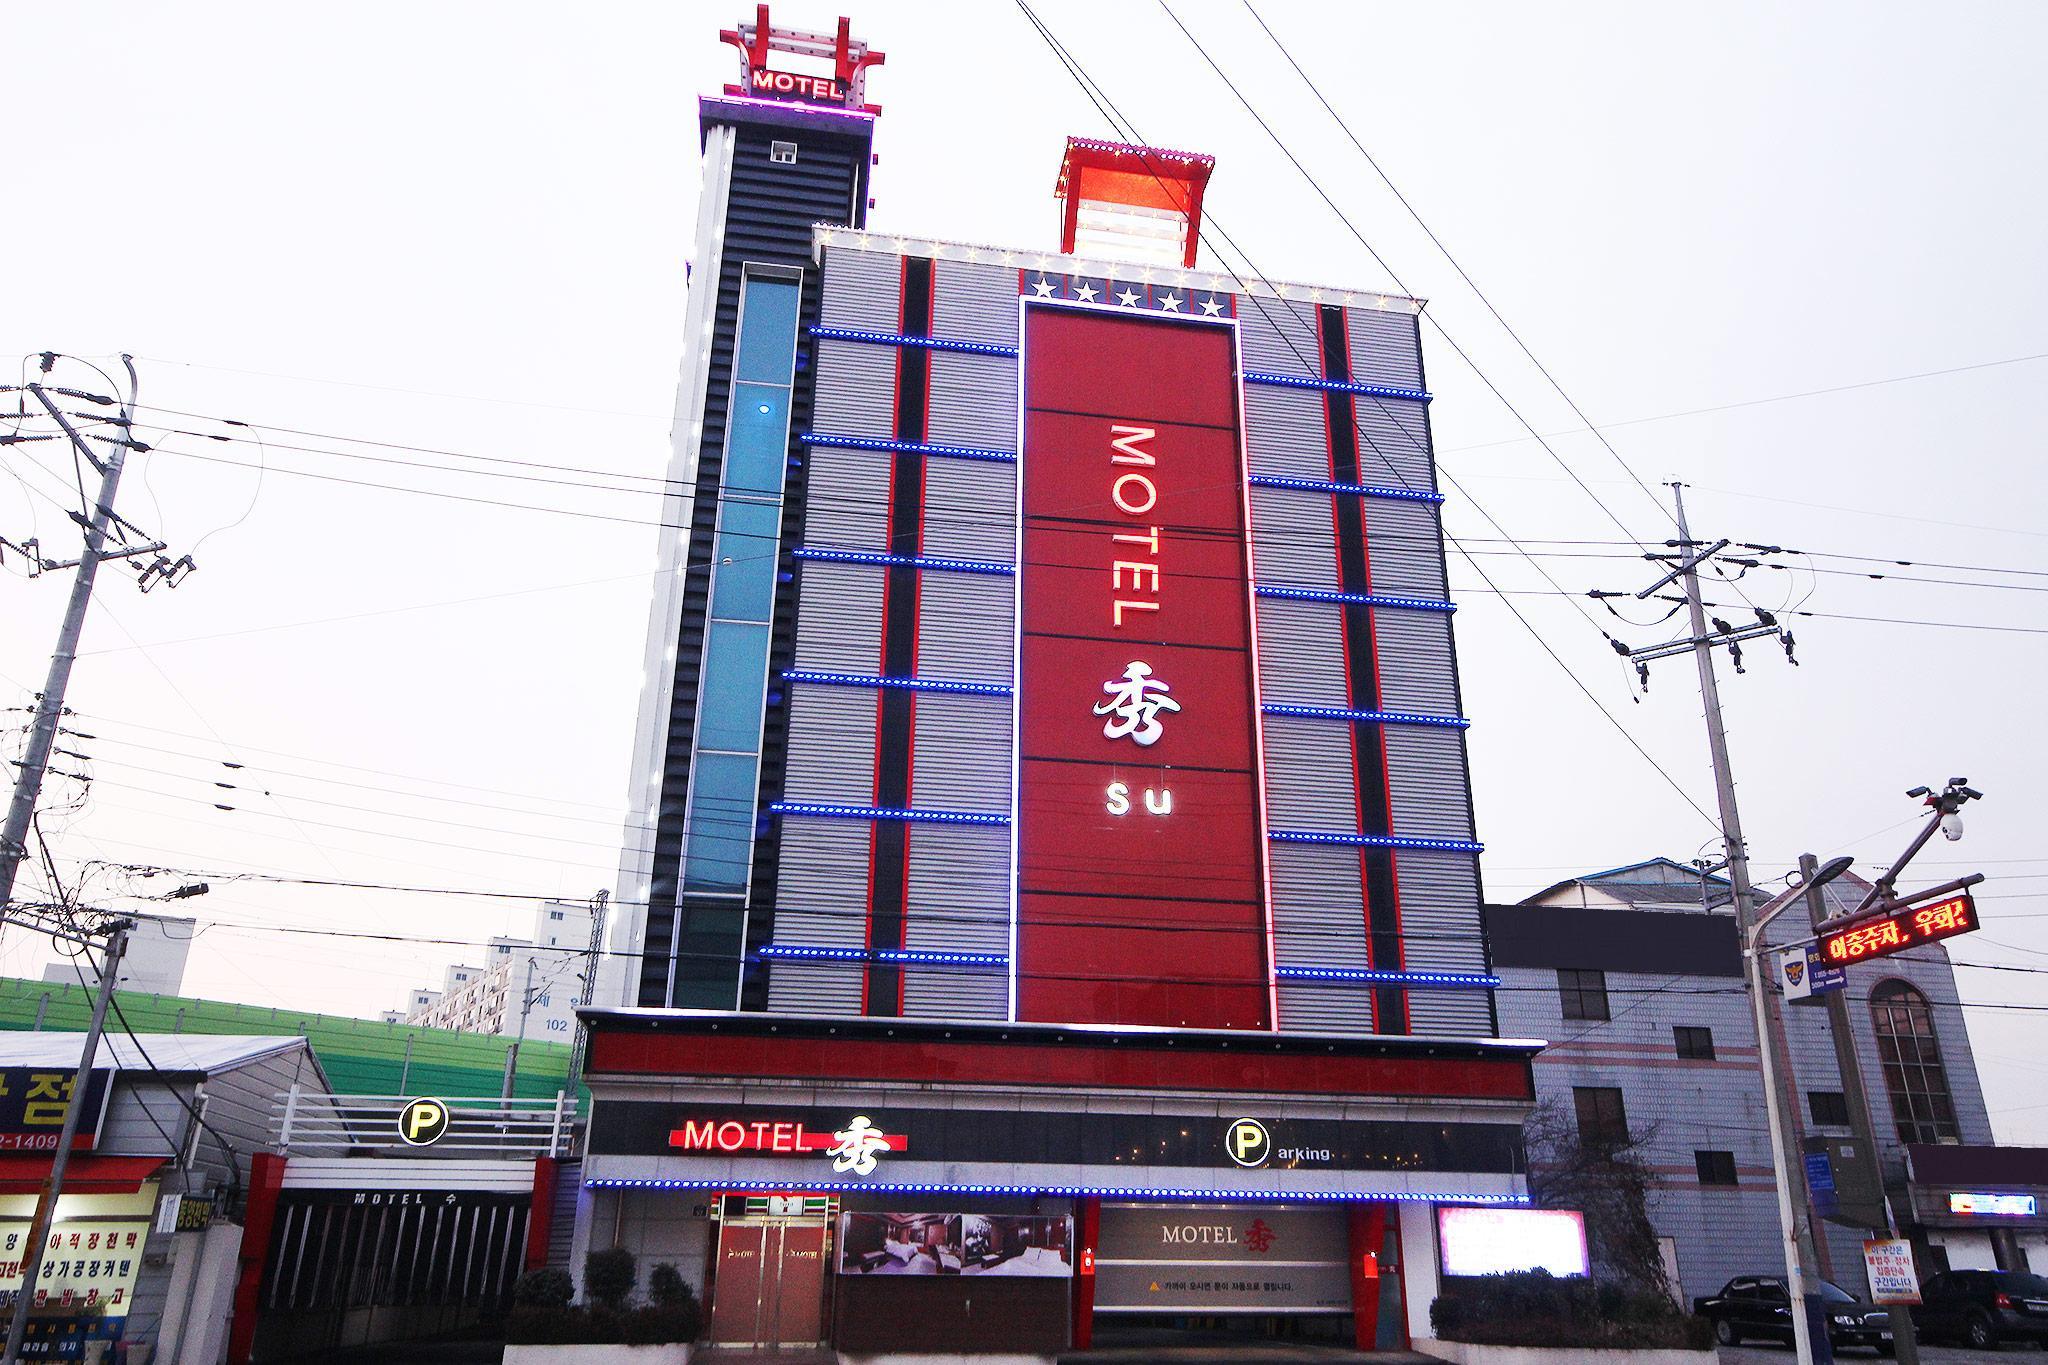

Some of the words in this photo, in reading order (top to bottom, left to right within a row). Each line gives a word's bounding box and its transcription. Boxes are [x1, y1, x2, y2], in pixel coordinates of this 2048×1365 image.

[752, 70, 845, 99] MOTEL
[1110, 424, 1160, 628] MOTEL
[1092, 659, 1181, 747] 秀
[546, 1019, 567, 1031] 102
[0, 1073, 79, 1125] 점
[409, 1104, 441, 1138] P
[684, 1120, 813, 1152] MOTEL
[825, 1115, 891, 1176] 秀
[354, 1193, 422, 1205] MOTEL
[1162, 1225, 1238, 1243] MOTEL
[1874, 1277, 1912, 1288] 구간입니다
